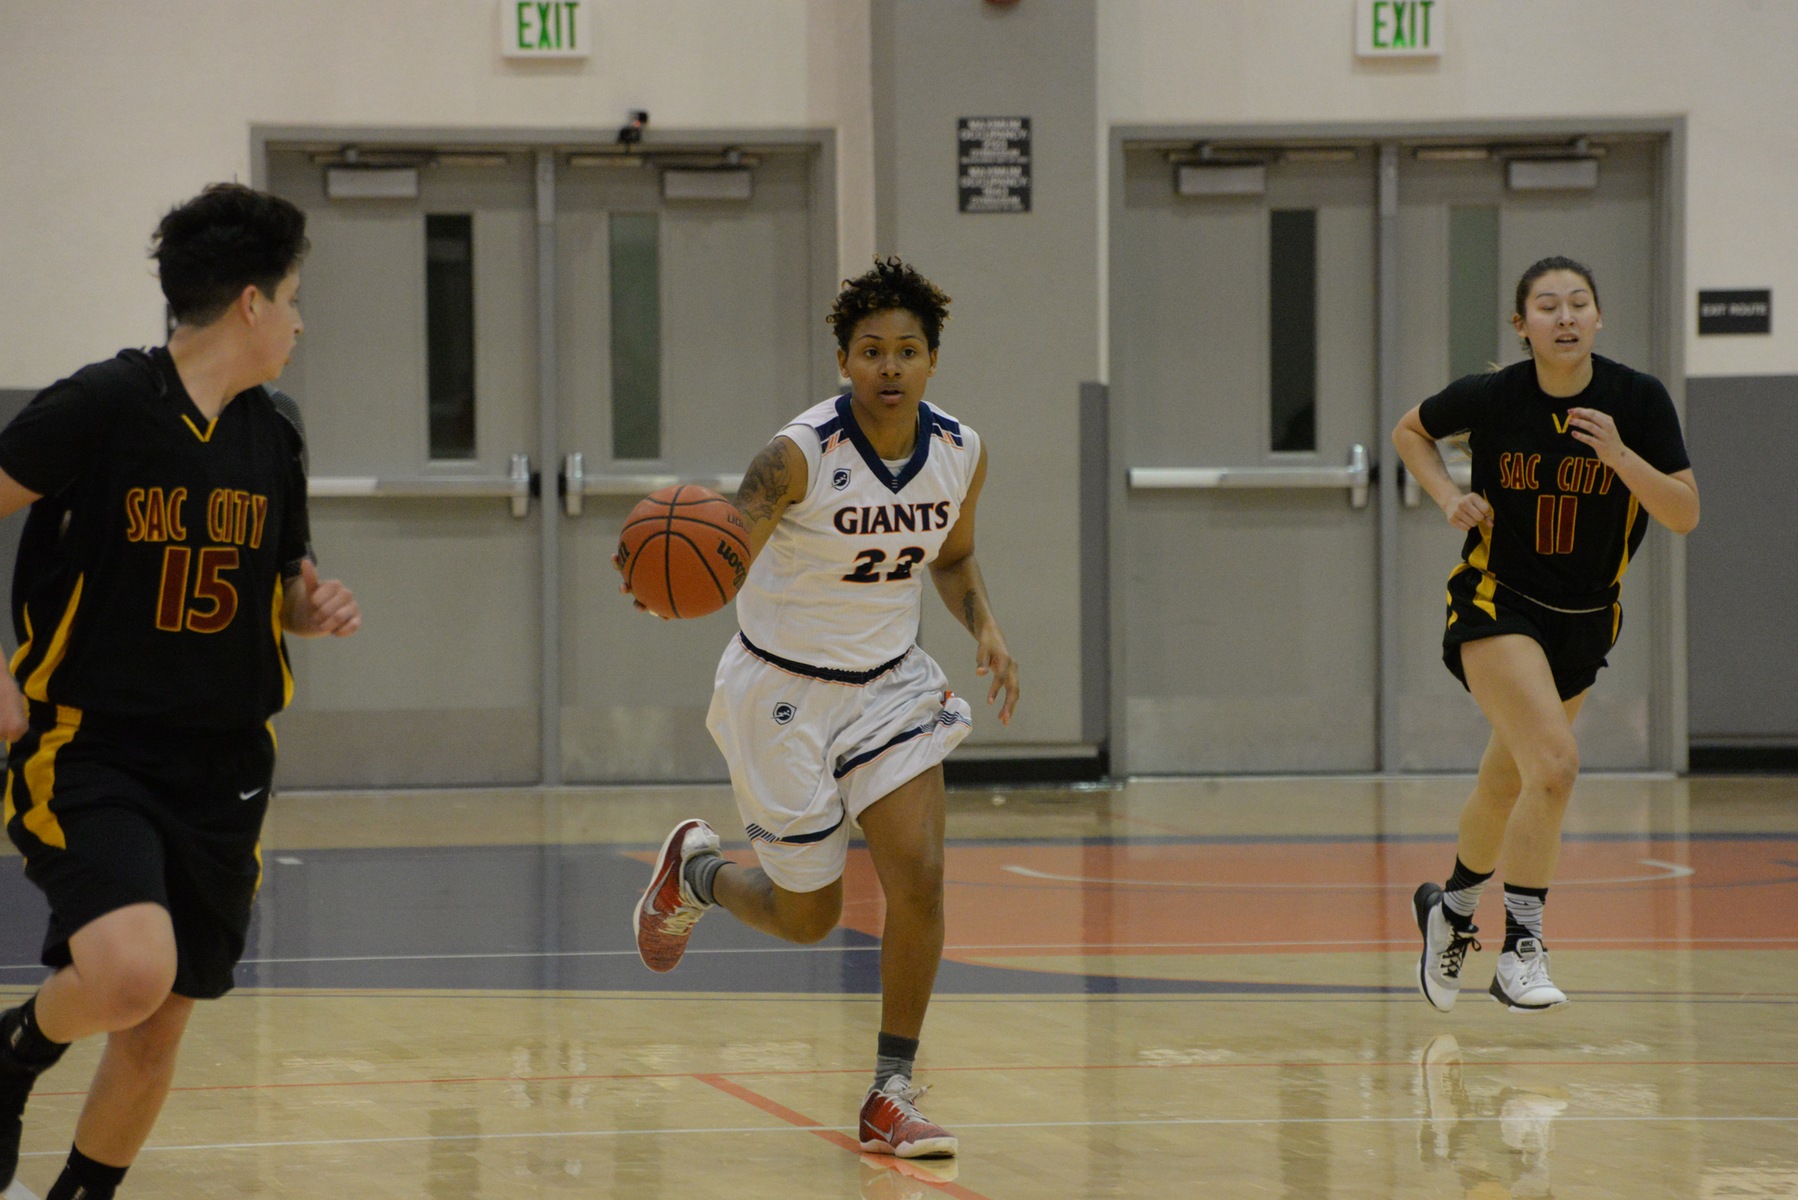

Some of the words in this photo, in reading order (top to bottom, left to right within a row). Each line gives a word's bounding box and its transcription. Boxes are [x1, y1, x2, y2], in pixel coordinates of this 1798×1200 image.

[516, 1, 580, 50] EXIT
[1372, 1, 1435, 49] EXIT
[1500, 452, 1541, 490] SAC
[1557, 456, 1615, 495] CITY
[126, 487, 188, 542] SAC
[207, 488, 268, 549] CITY
[833, 501, 950, 535] GIANTS
[1535, 494, 1578, 555] 11
[156, 546, 240, 634] 15
